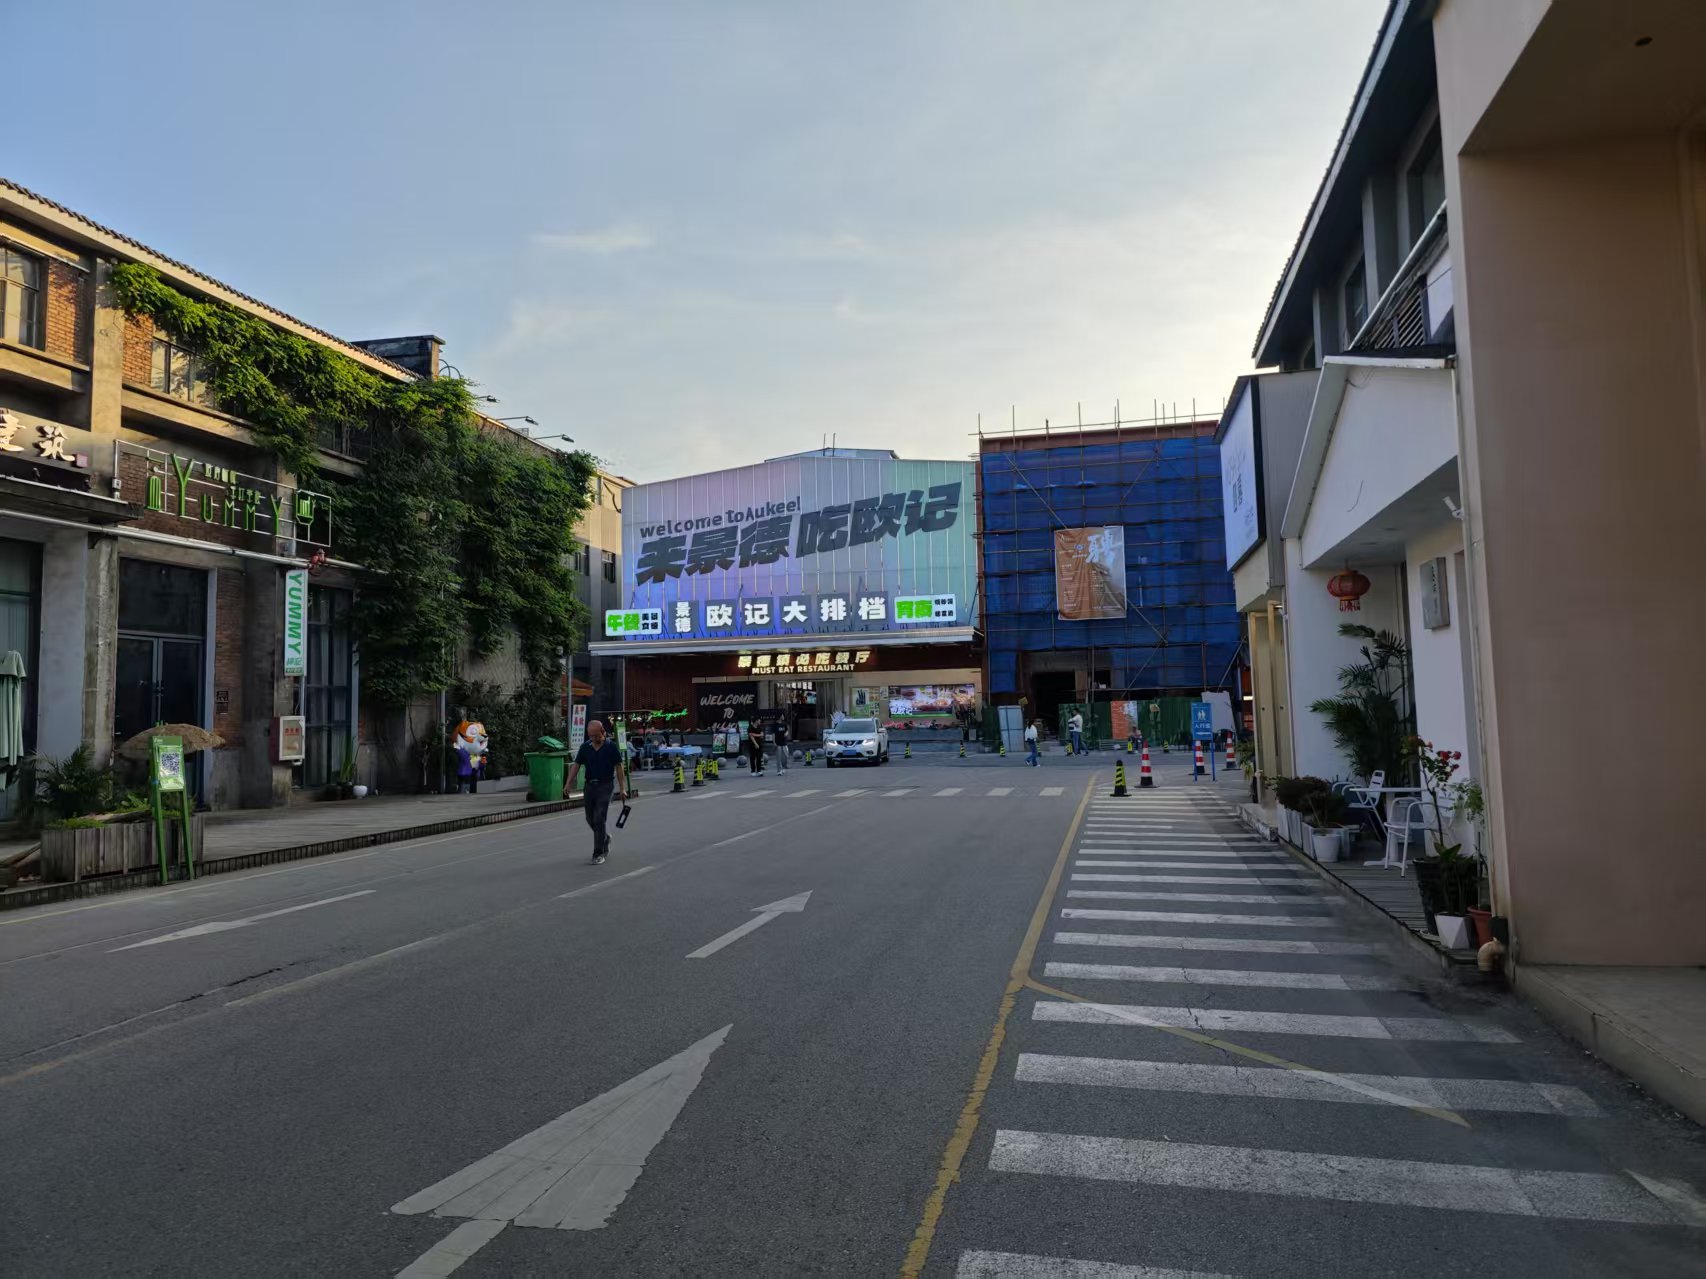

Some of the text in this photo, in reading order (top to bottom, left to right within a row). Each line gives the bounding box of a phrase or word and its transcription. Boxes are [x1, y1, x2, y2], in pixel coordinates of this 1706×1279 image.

[170, 451, 285, 537] YUMMY
[640, 514, 723, 538] welcome
[288, 572, 303, 655] YUMMY
[675, 601, 692, 633] 景德
[706, 596, 886, 627] 欧记大排档
[752, 664, 855, 675] MUST EAT RESTAURANT
[700, 693, 755, 706] WELCOME
[723, 707, 735, 719] TO
